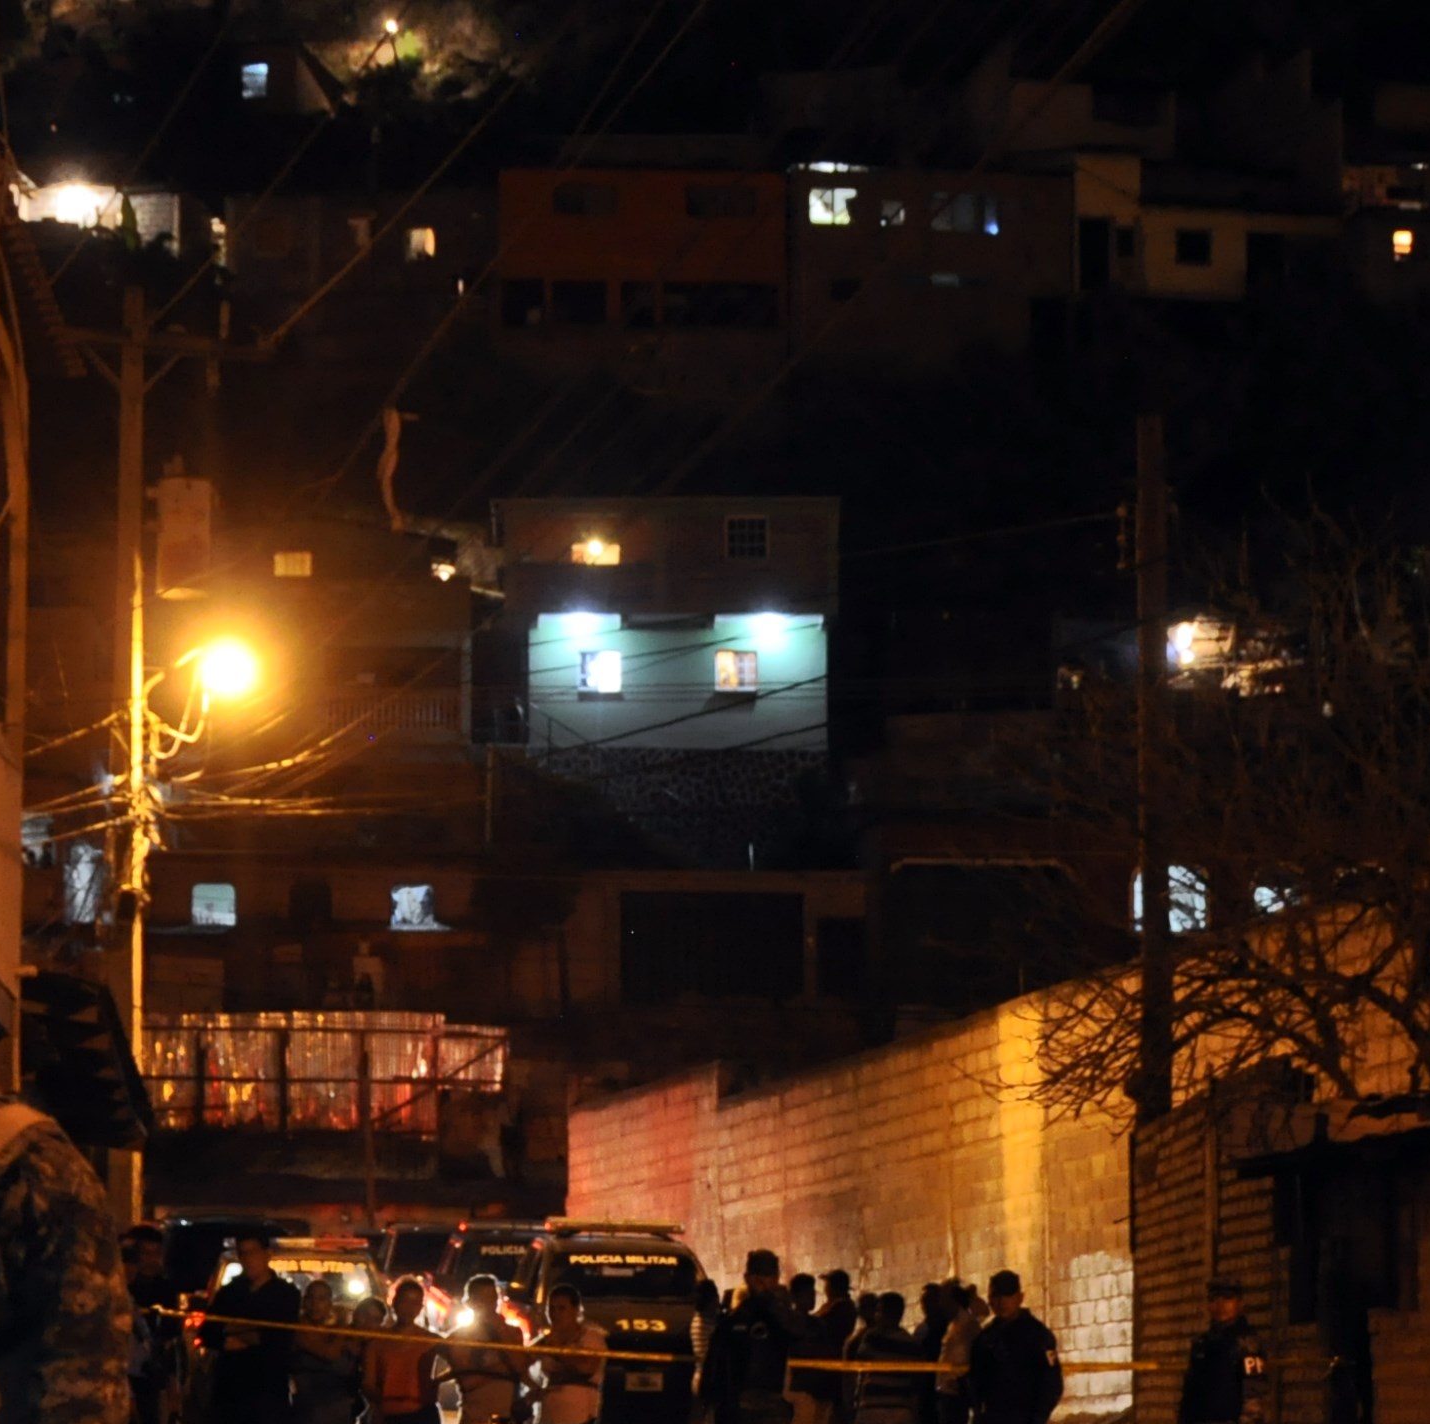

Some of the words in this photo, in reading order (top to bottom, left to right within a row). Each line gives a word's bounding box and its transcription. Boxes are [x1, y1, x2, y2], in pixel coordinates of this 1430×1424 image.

[481, 1245, 527, 1256] POLICIA
[569, 1254, 623, 1265] POLICIA
[625, 1255, 678, 1266] MILITAR
[616, 1318, 668, 1332] 153
